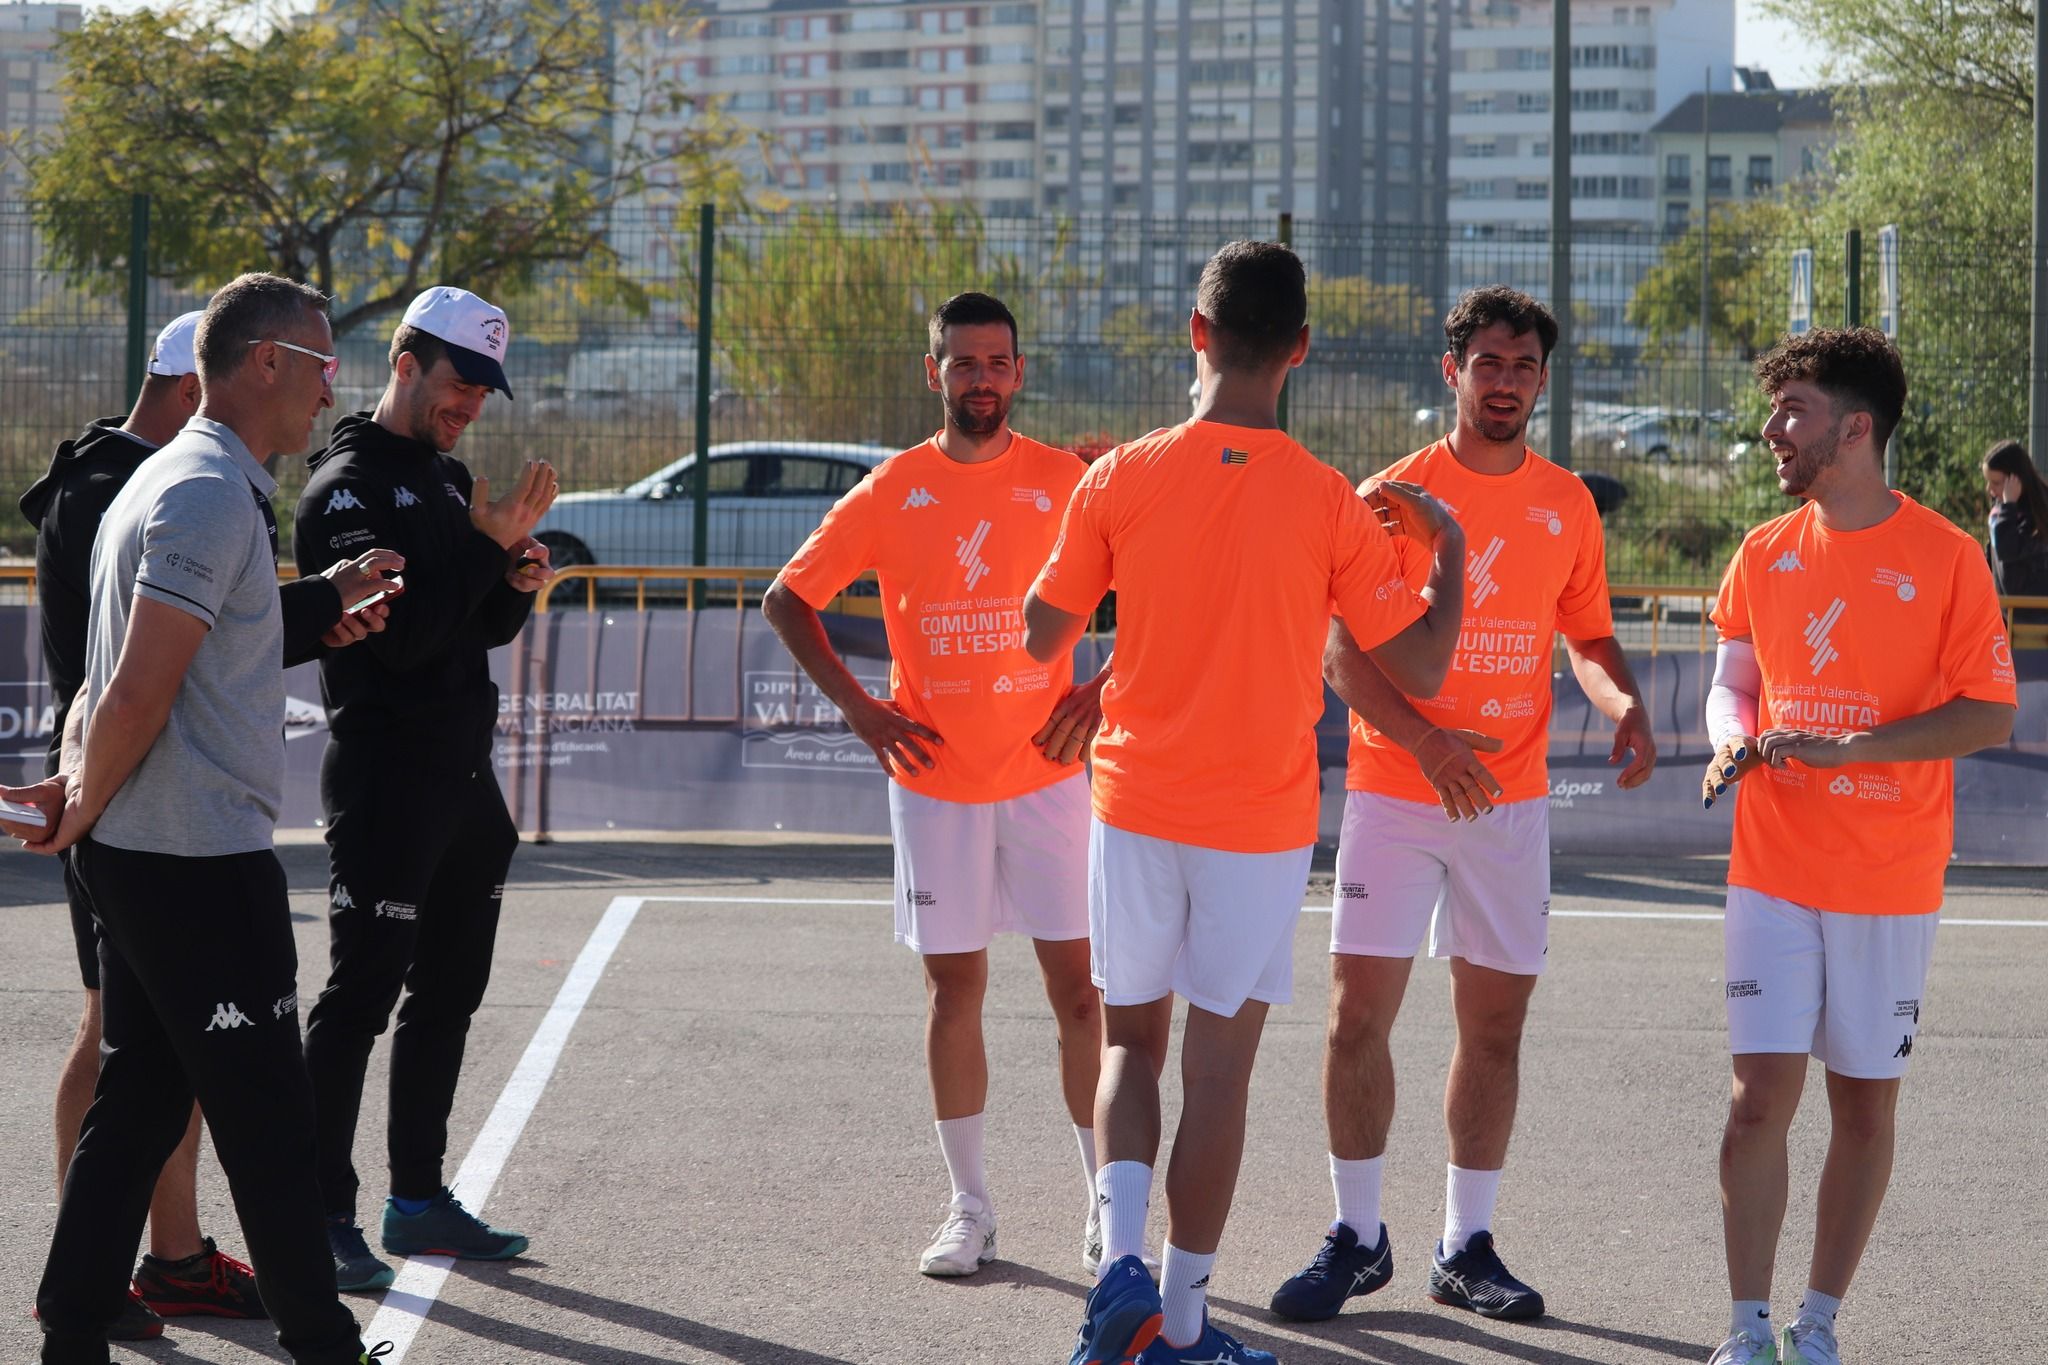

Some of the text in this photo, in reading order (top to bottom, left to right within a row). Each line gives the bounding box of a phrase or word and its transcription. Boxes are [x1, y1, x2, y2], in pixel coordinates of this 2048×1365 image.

[920, 611, 1027, 636] COMUNITA
[1480, 616, 1537, 631] Valenciana
[930, 631, 1026, 656] DE L'ESPO
[1453, 653, 1540, 675] L'ESPORT
[784, 745, 878, 764] Área de Cultura
[1549, 778, 1604, 801] ópez
[1857, 791, 1901, 802] ALFONSO
